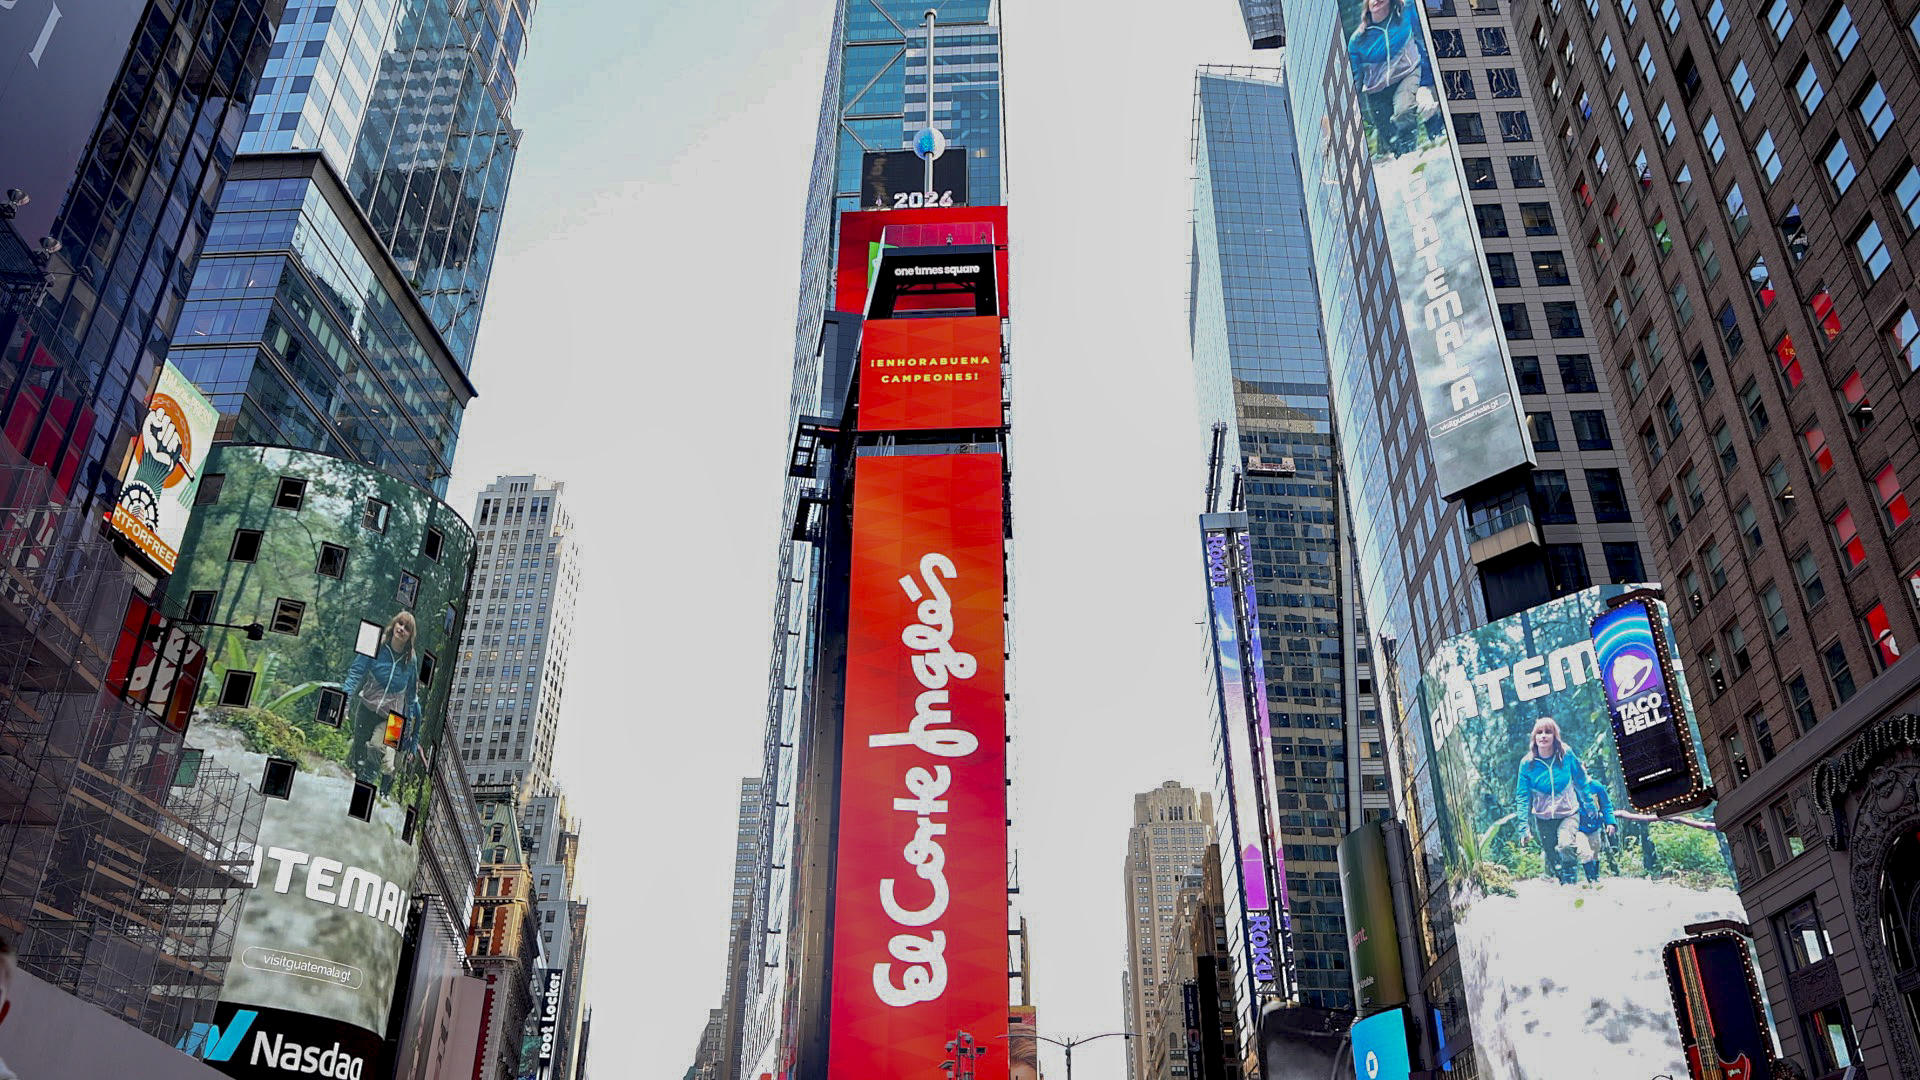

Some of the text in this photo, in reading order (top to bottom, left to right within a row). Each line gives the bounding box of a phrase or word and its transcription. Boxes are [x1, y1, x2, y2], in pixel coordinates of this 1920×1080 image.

[894, 265, 981, 277] one times square
[1406, 176, 1480, 412] GUATEMALA
[881, 372, 979, 384] CAMPEONES!
[1430, 639, 1602, 752] GUATEM
[1615, 692, 1662, 721] TACO
[1622, 708, 1668, 736] BELL
[868, 552, 980, 1007] El Corte Inglés
[263, 953, 351, 983] visitguatemala.gt
[539, 973, 561, 1059] Foot Locker
[250, 1030, 364, 1080] Nasdaq
